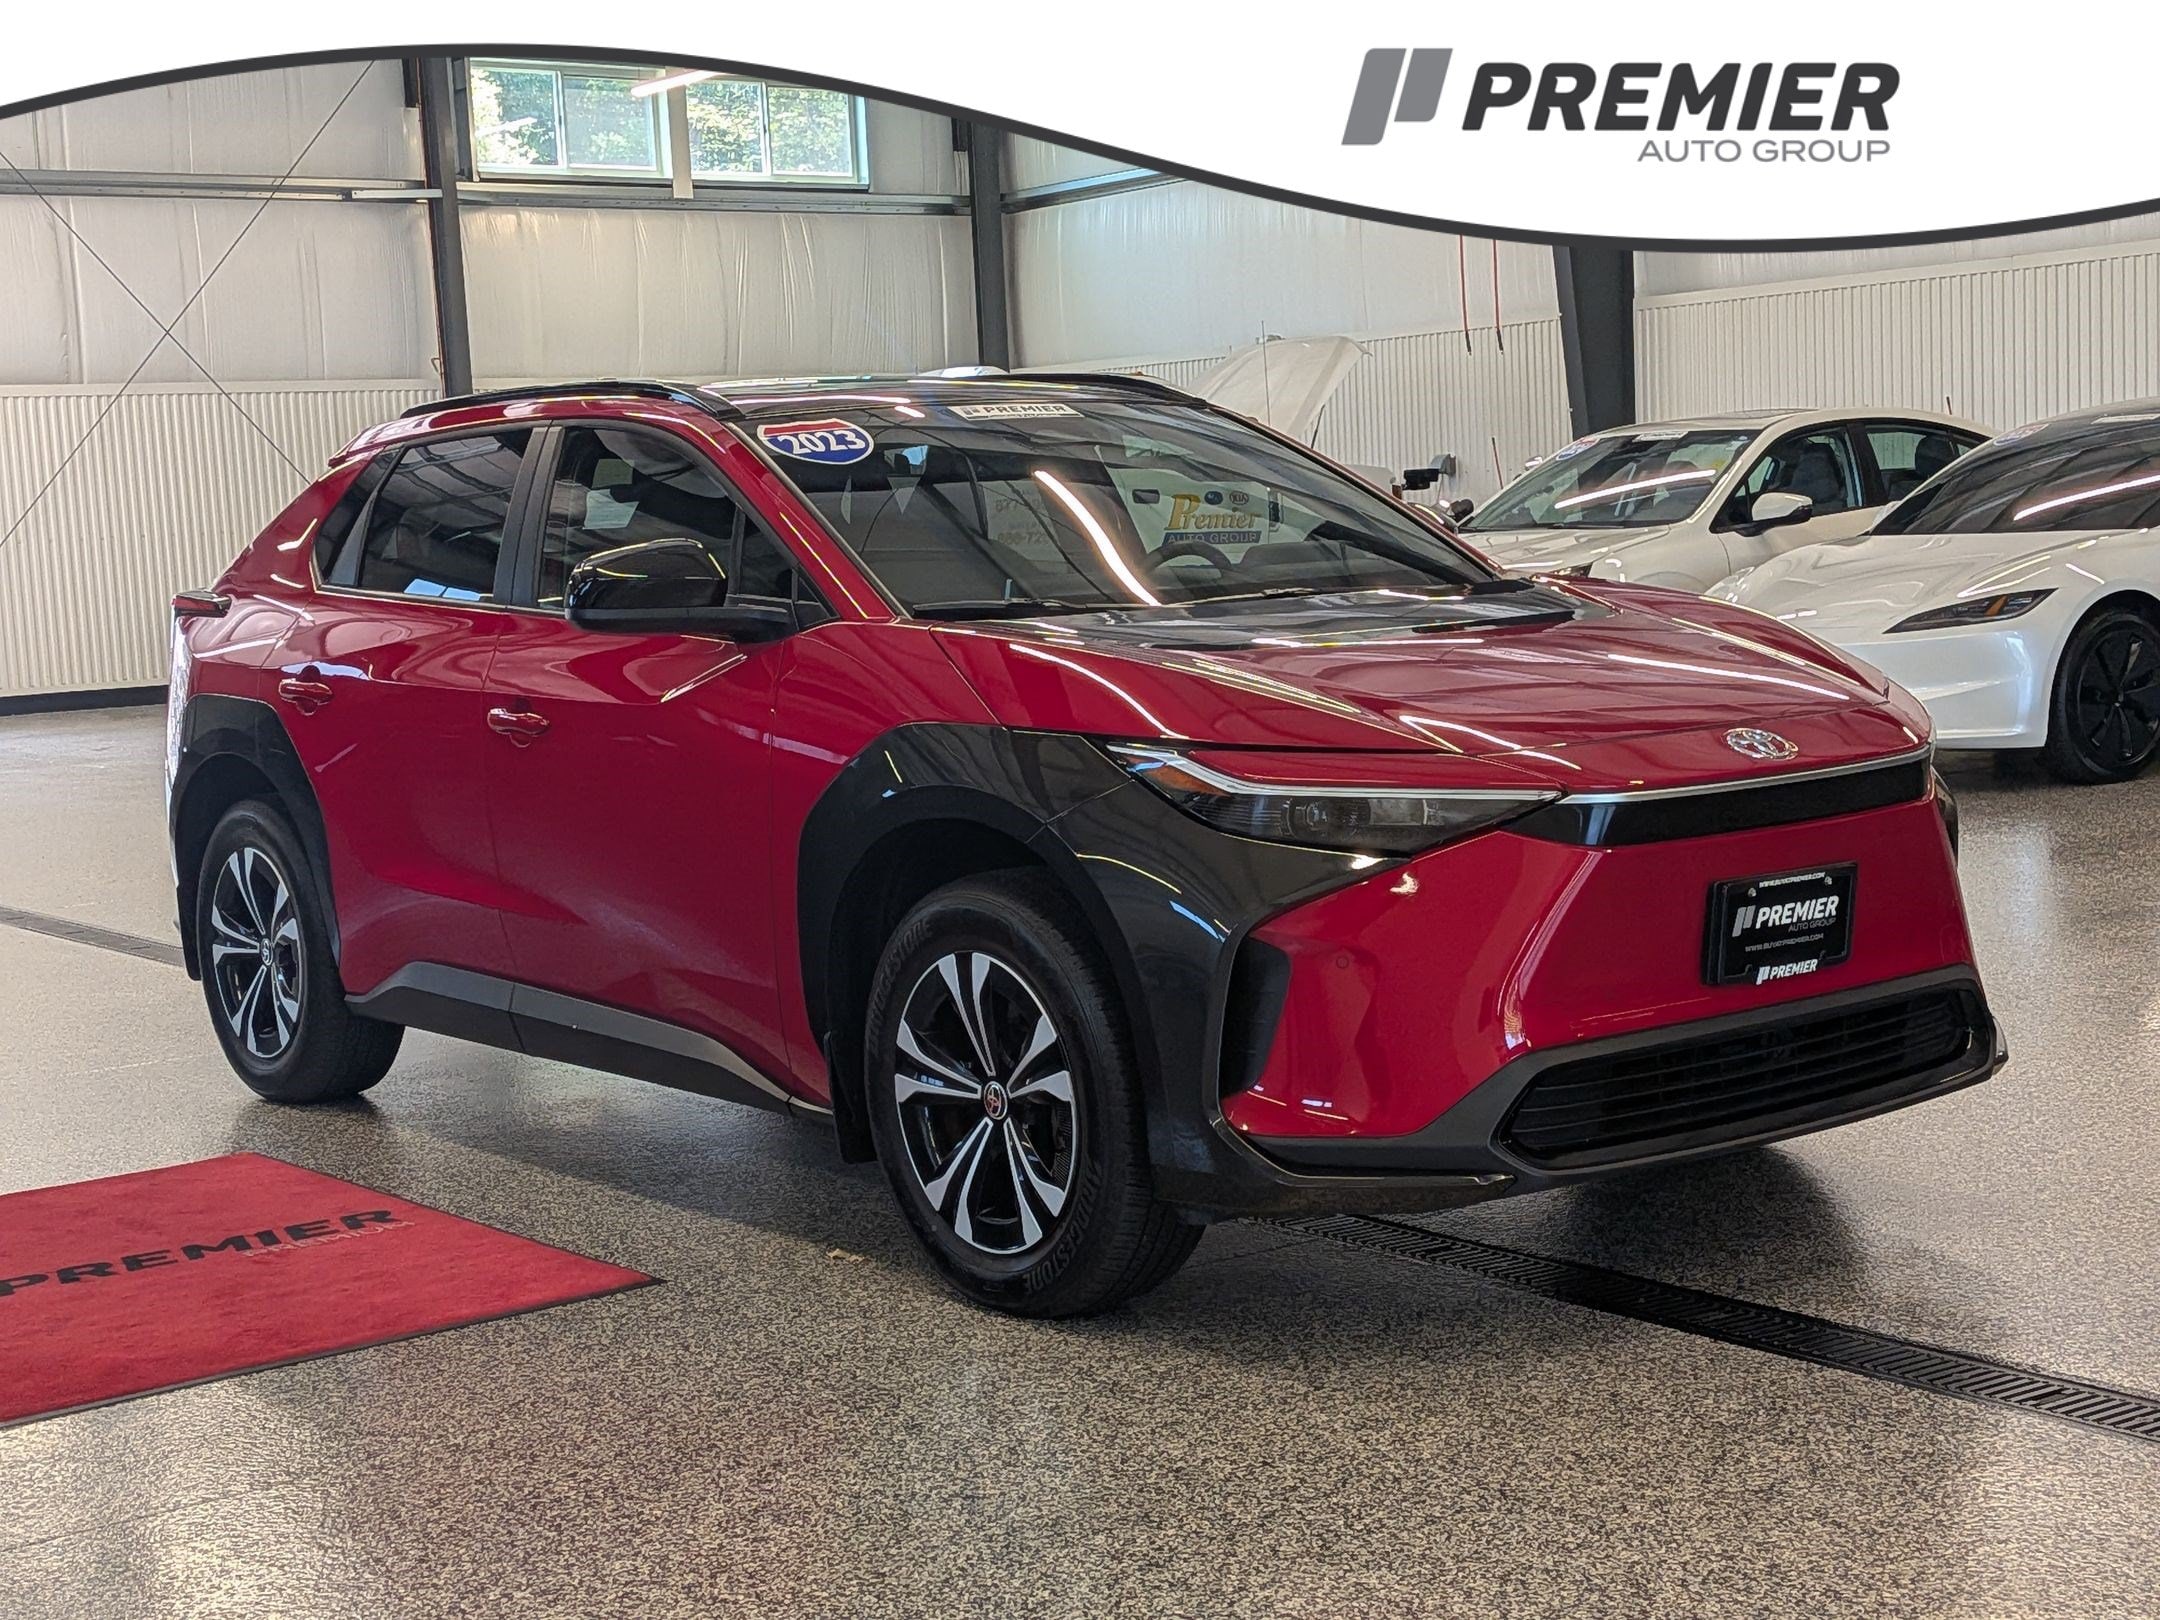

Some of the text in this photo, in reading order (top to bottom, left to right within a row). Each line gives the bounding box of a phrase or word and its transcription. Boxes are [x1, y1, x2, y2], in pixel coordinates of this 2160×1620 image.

[981, 404, 1066, 414] PREMIER
[777, 429, 866, 455] 2023
[1163, 493, 1263, 531] Premier
[1167, 532, 1258, 545] AUTO GROUP
[1755, 895, 1840, 930] PREMIER
[1788, 917, 1837, 933] AUTO GROUP
[1769, 958, 1819, 981] PREMIER
[0, 1210, 402, 1297] PREMIER
